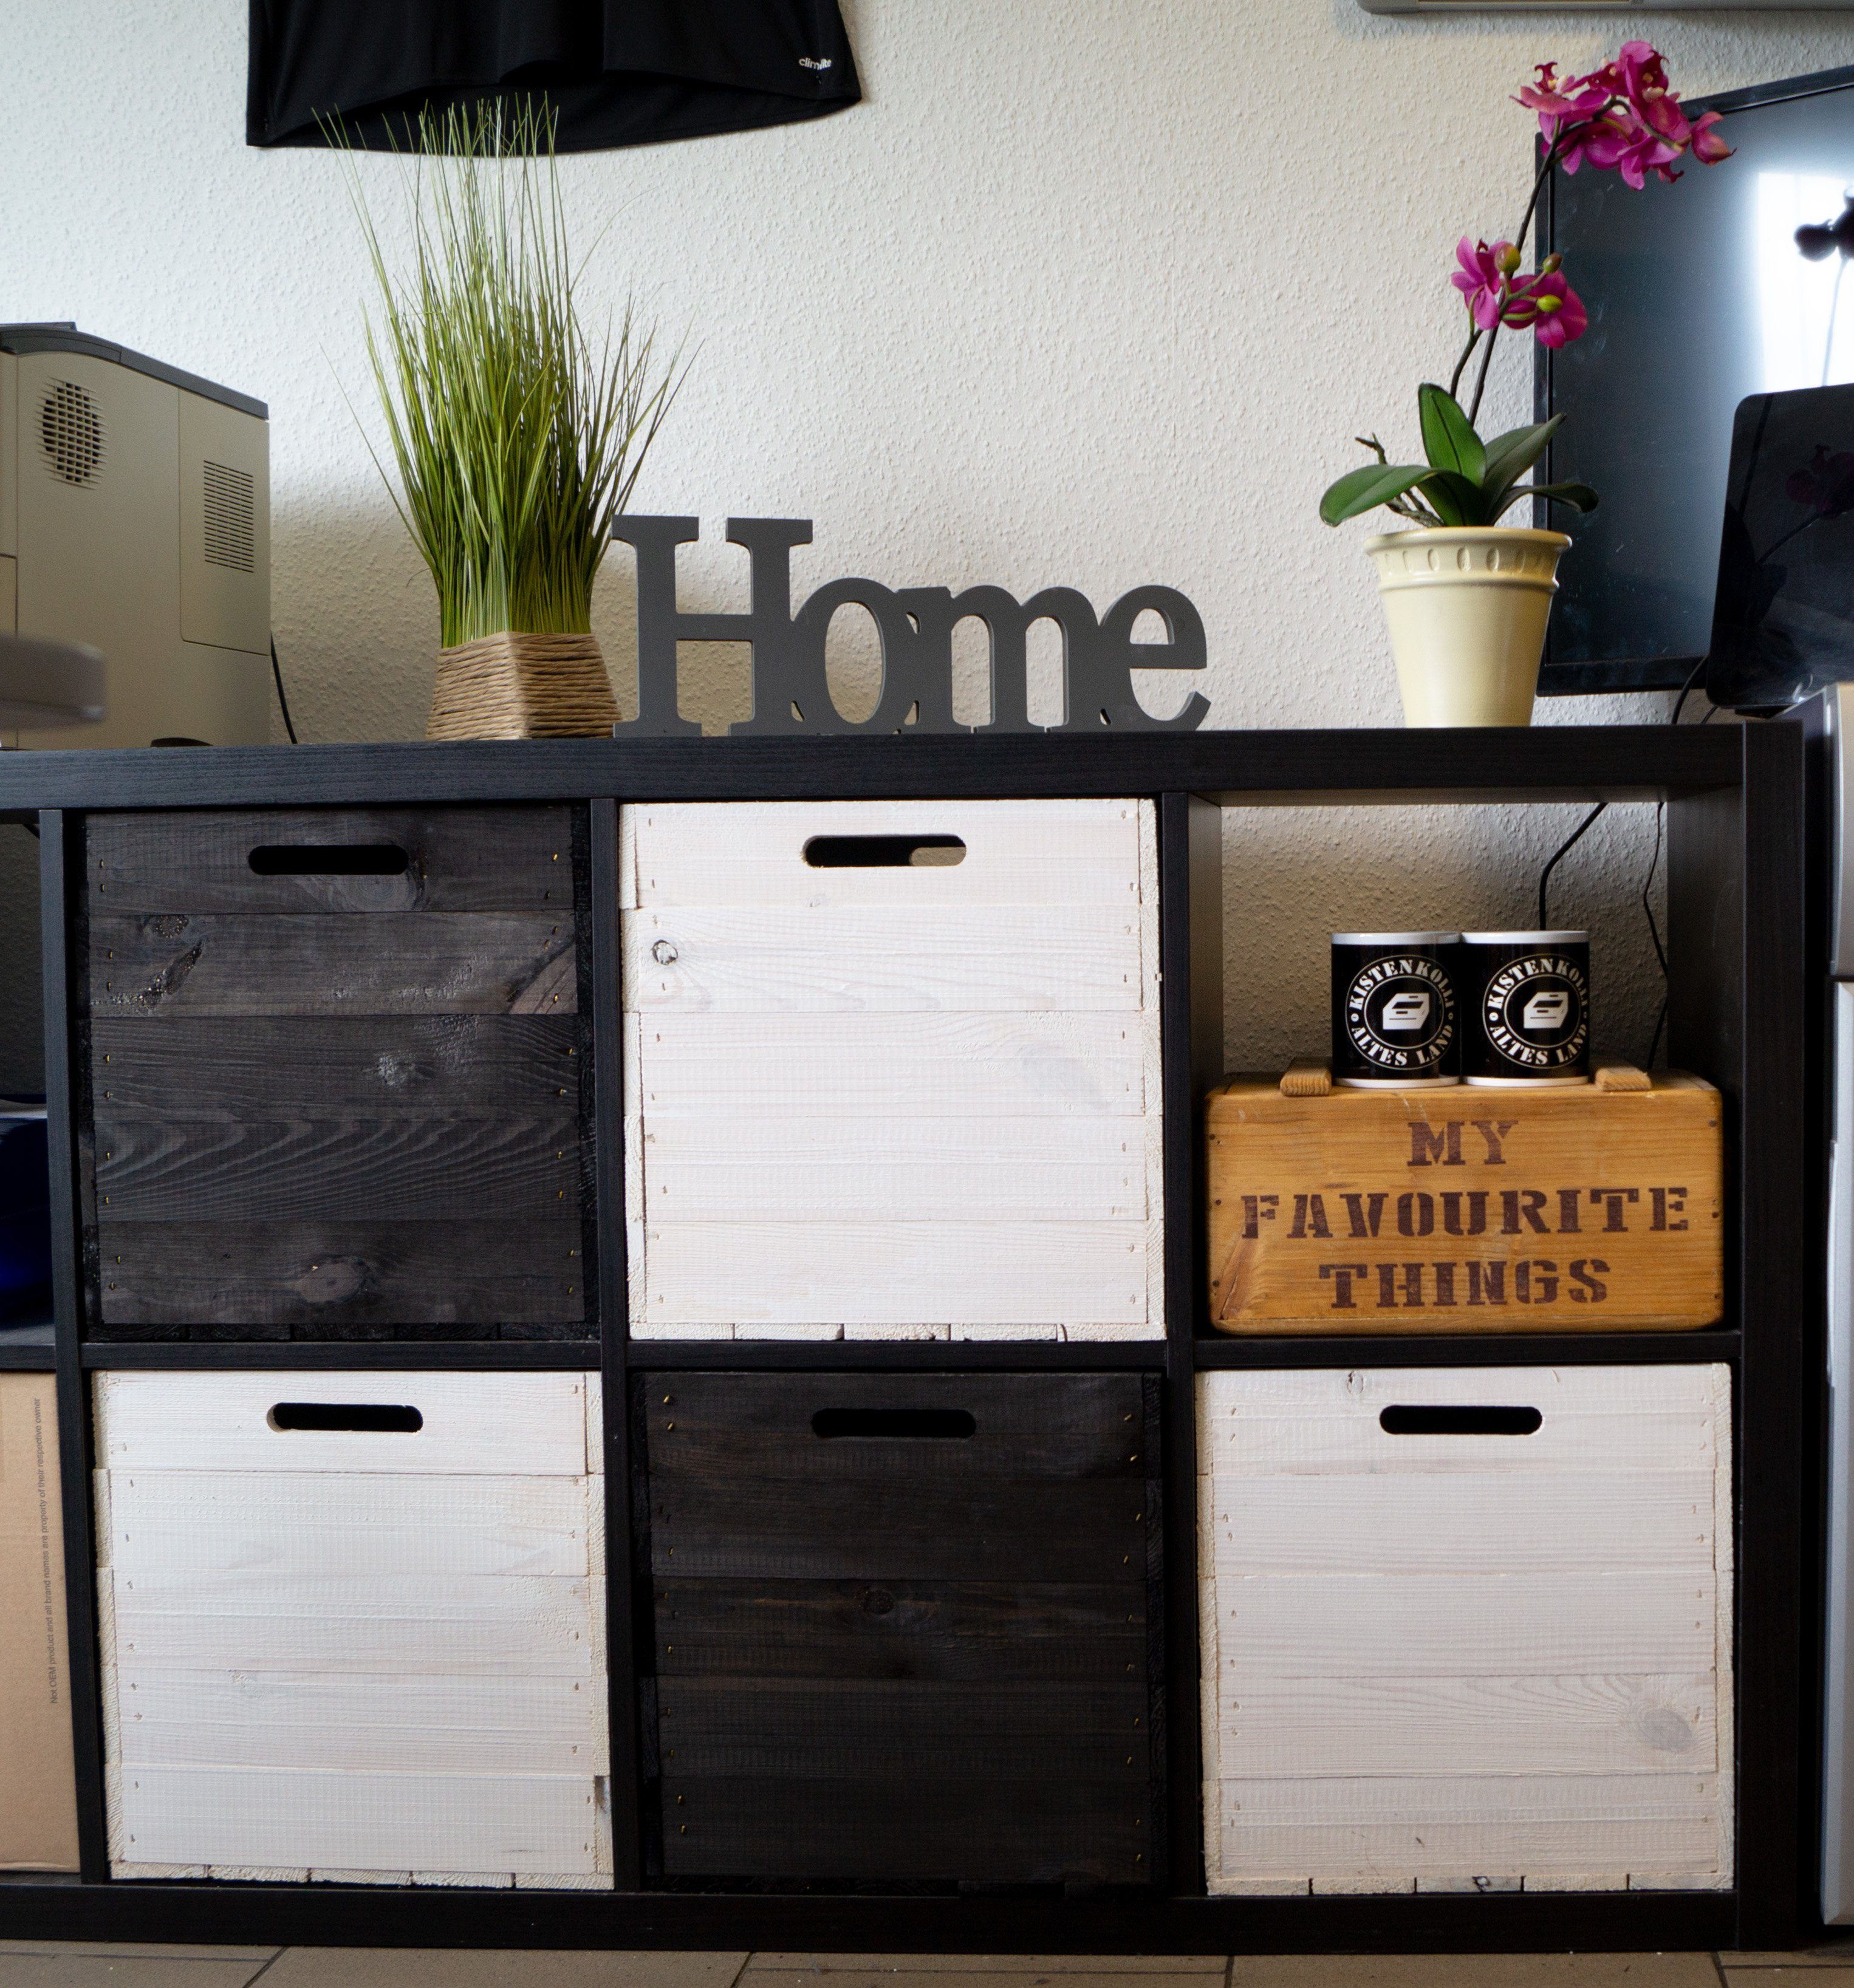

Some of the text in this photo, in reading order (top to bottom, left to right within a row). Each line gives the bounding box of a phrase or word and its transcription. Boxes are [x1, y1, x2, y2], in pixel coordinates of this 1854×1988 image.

[611, 514, 1211, 737] Home
[1352, 1024, 1453, 1066] ALTES LAND
[1489, 1023, 1587, 1065] ALTES LAND
[1406, 1120, 1519, 1167] MY
[1240, 1186, 1689, 1240] FAVOURITE
[1318, 1259, 1610, 1309] THINGS
[35, 1425, 44, 1467] respective
[38, 1488, 46, 1497] of
[39, 1499, 49, 1533] property
[43, 1580, 52, 1604] brand
[47, 1634, 56, 1664] product
